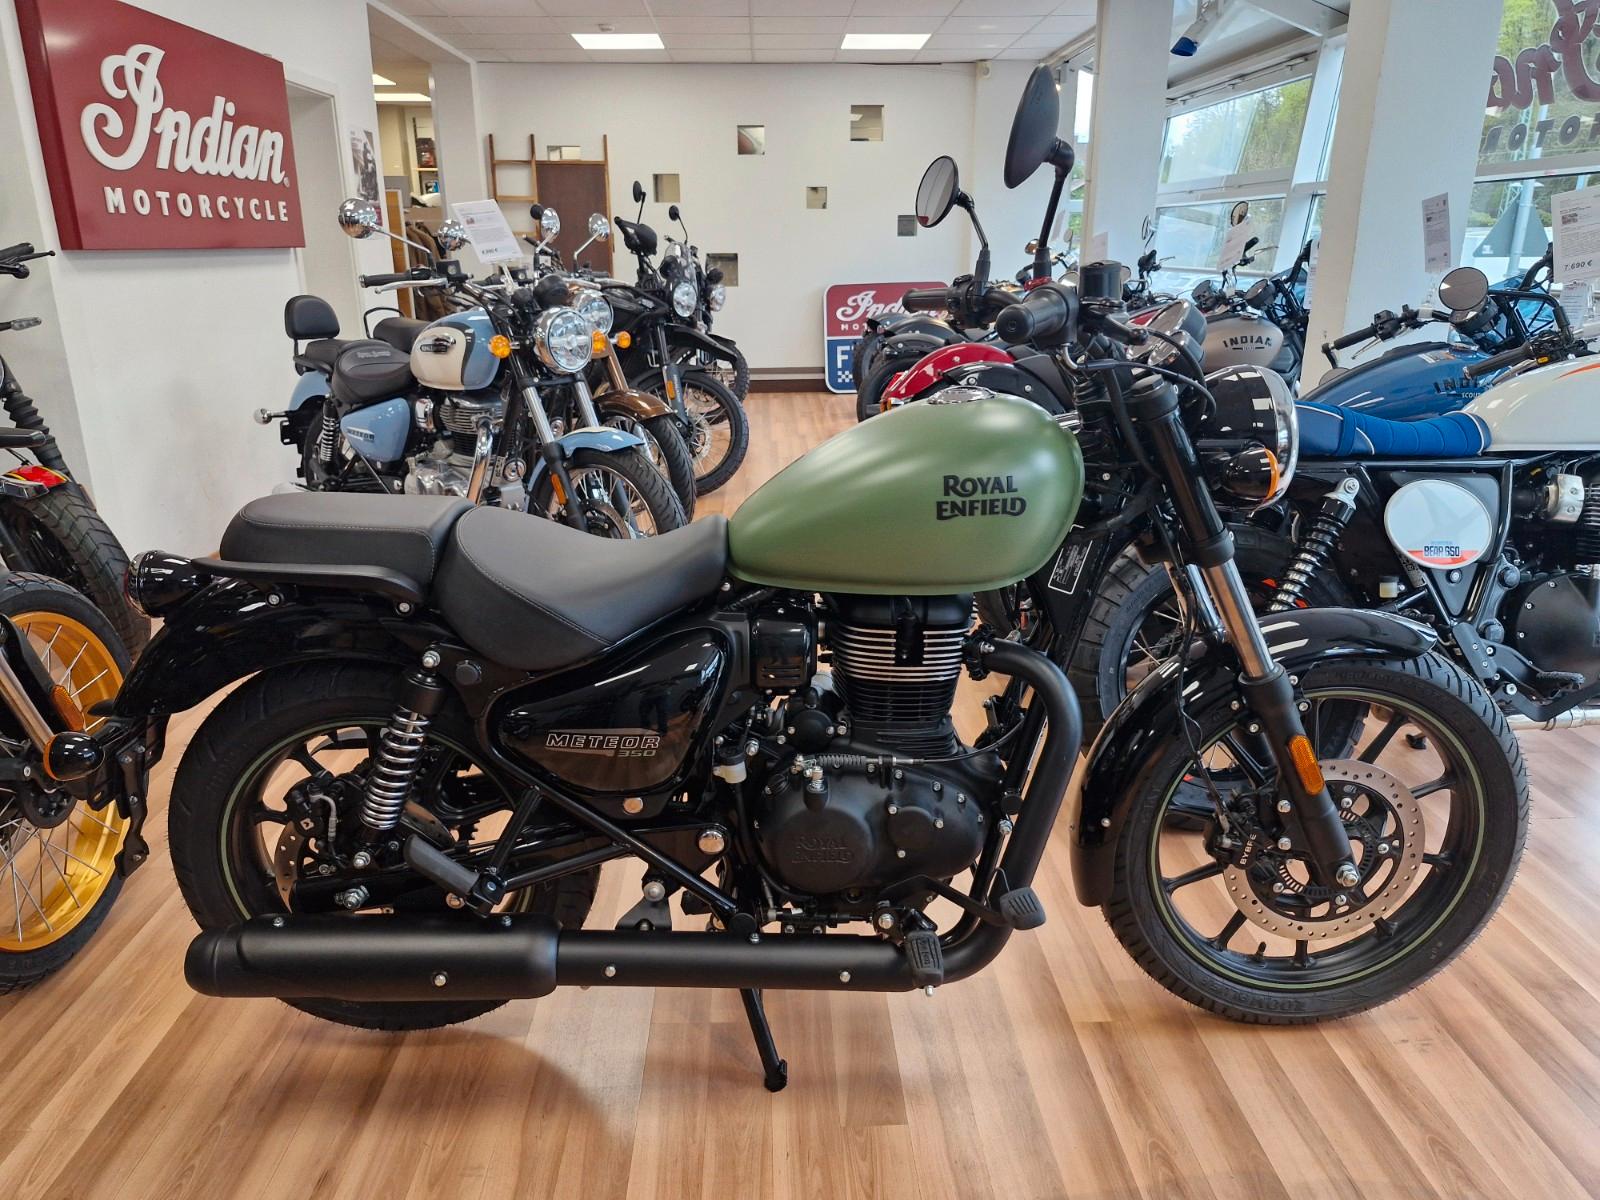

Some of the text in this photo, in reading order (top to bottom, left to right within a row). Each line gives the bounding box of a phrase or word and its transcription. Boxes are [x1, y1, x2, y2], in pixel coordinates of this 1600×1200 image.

[80, 43, 285, 184] Indian
[104, 186, 289, 221] MOTORCYCLE
[1223, 335, 1272, 348] INDIAN
[943, 475, 1018, 497] ROYAL
[936, 497, 1027, 520] ENFIELD
[546, 734, 660, 749] METEOR
[1240, 833, 1257, 865] BYBRE
